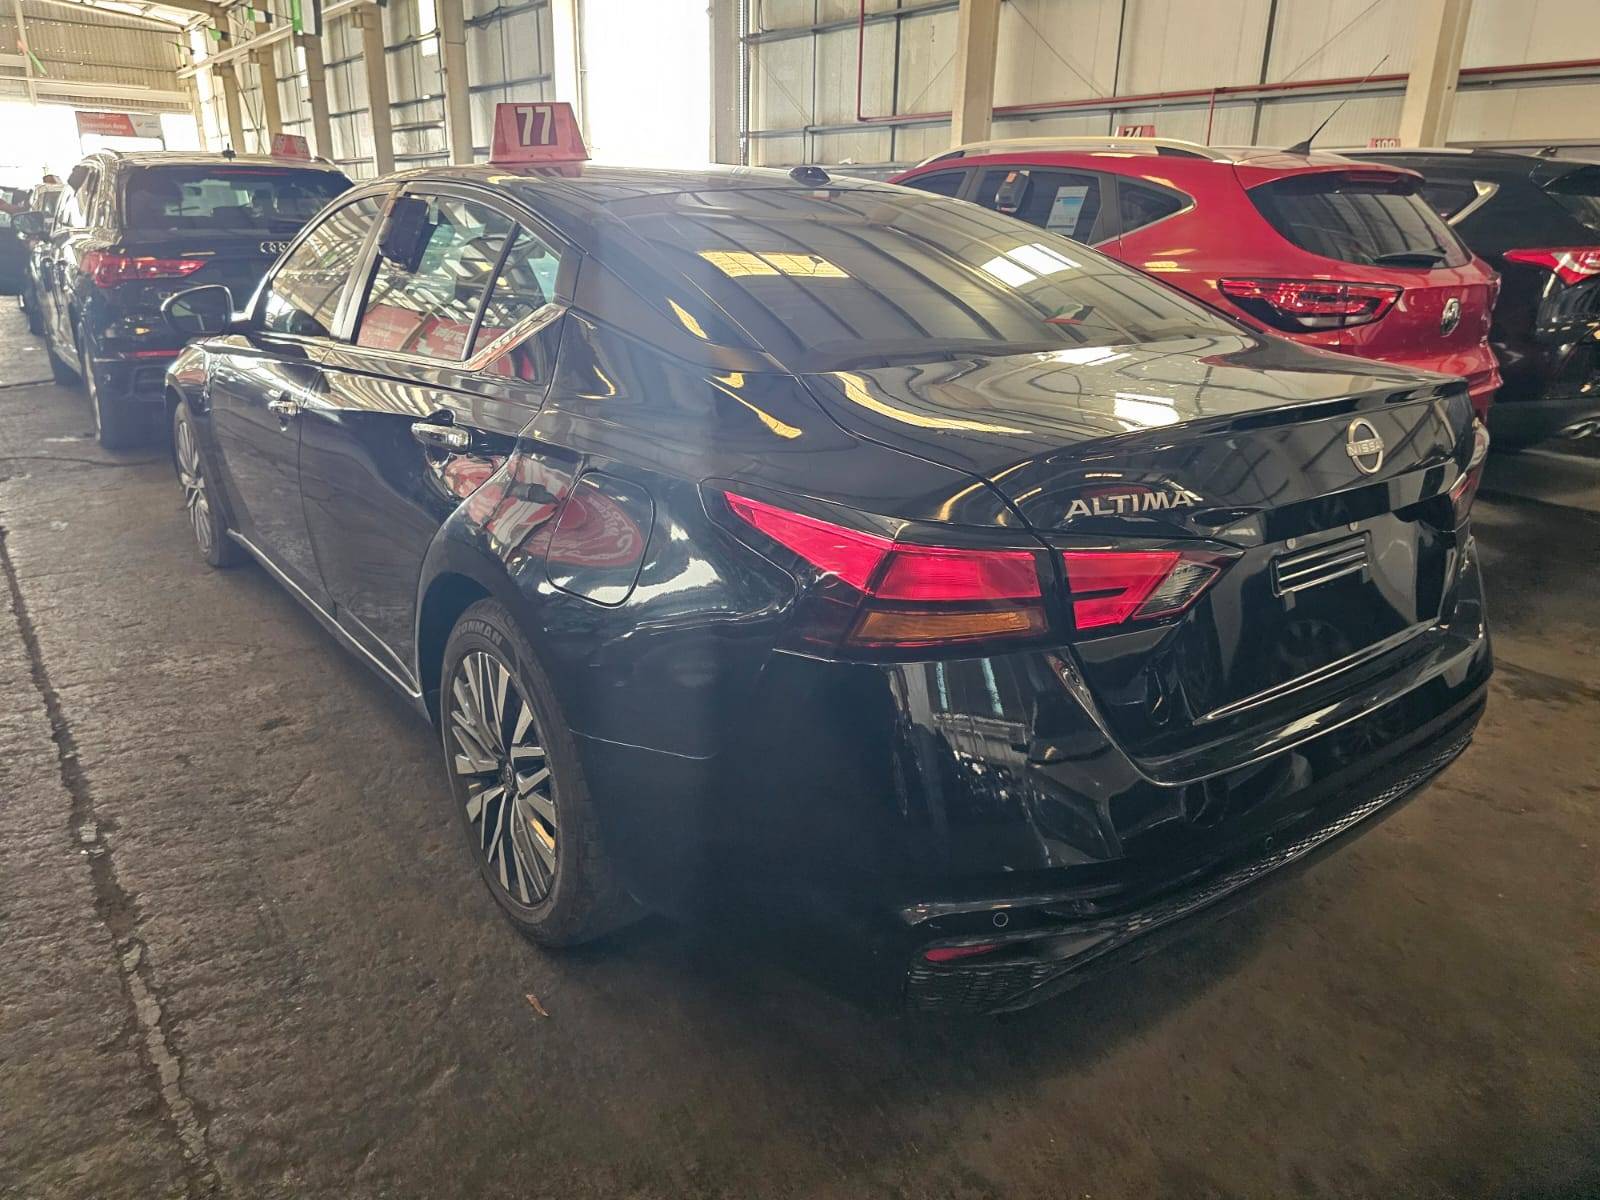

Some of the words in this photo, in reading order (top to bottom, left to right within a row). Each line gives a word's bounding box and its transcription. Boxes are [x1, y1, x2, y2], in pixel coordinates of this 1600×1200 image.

[517, 106, 552, 146] 77
[1347, 439, 1384, 456] NISSA
[1064, 490, 1195, 520] ALTIMA
[452, 620, 503, 646] RONMAN
